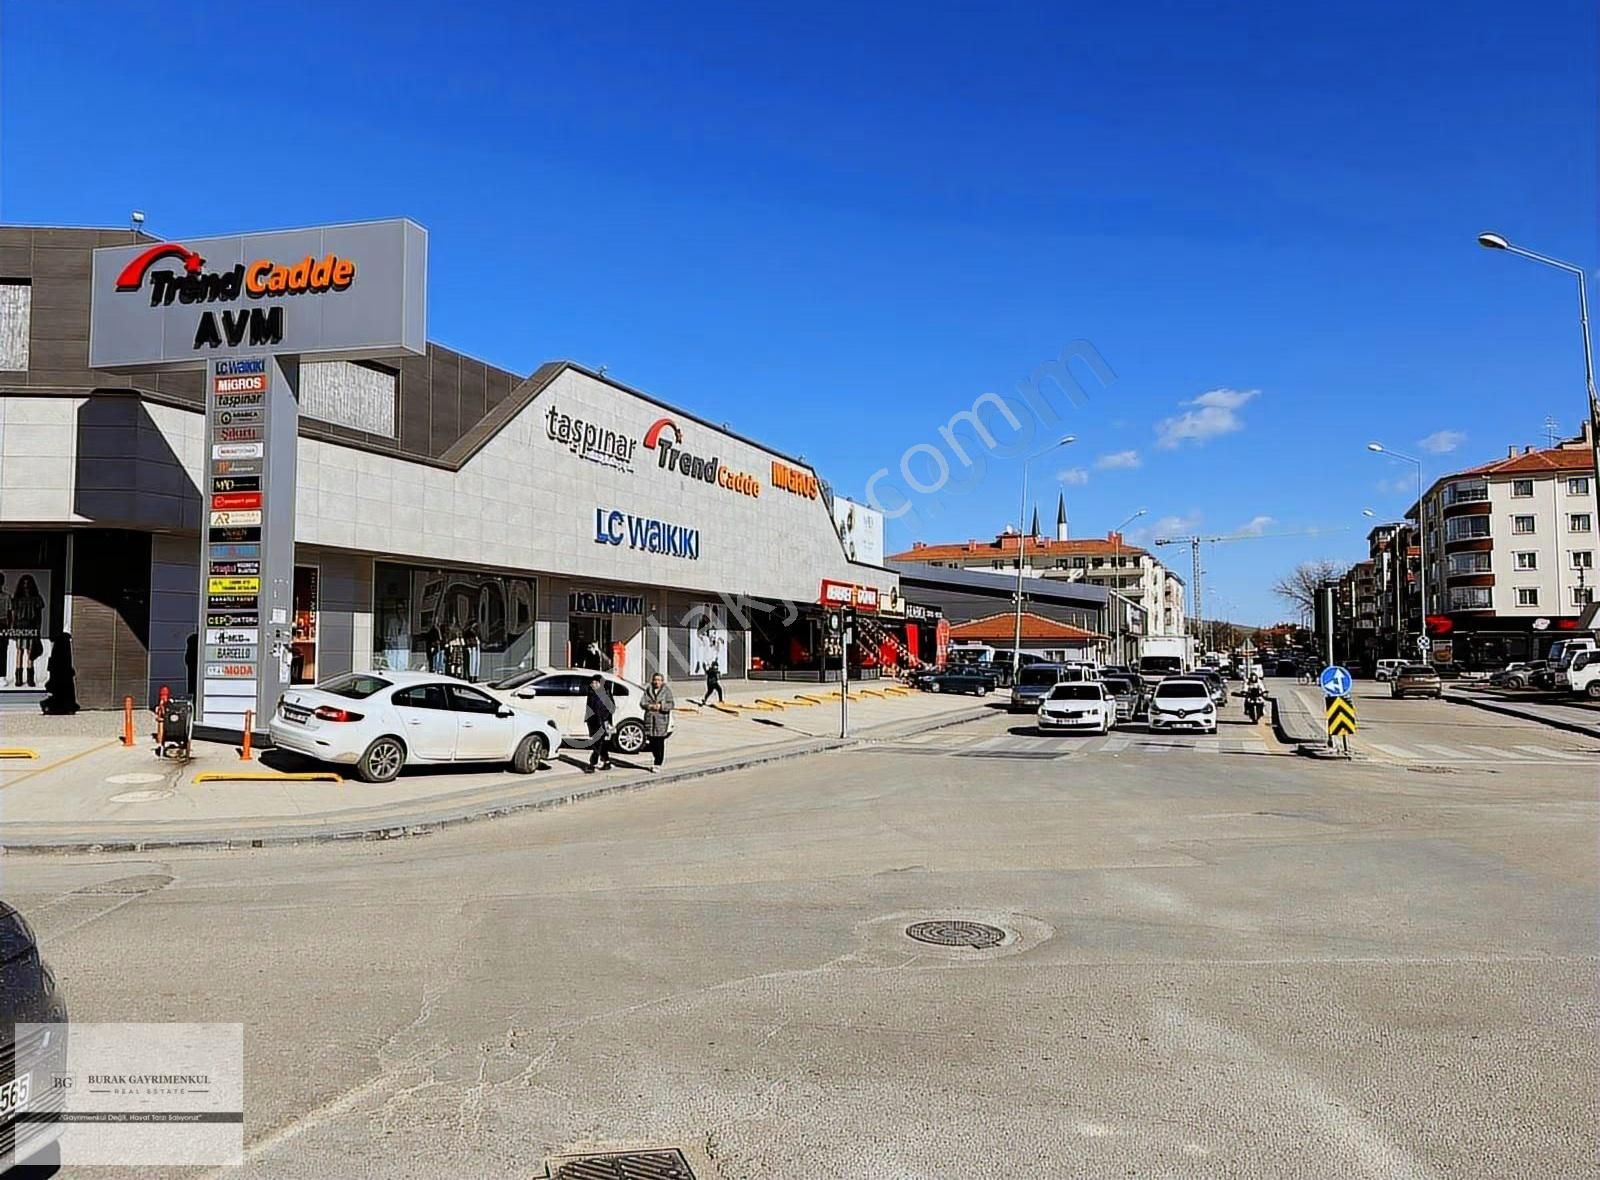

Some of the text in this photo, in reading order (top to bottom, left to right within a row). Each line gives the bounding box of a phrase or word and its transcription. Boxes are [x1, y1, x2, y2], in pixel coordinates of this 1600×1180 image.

[150, 254, 355, 307] Trend Cadde
[193, 307, 284, 349] AVM
[216, 361, 228, 375] LC
[658, 438, 719, 484] Trend
[718, 466, 761, 499] Cadde
[594, 508, 625, 546] LC
